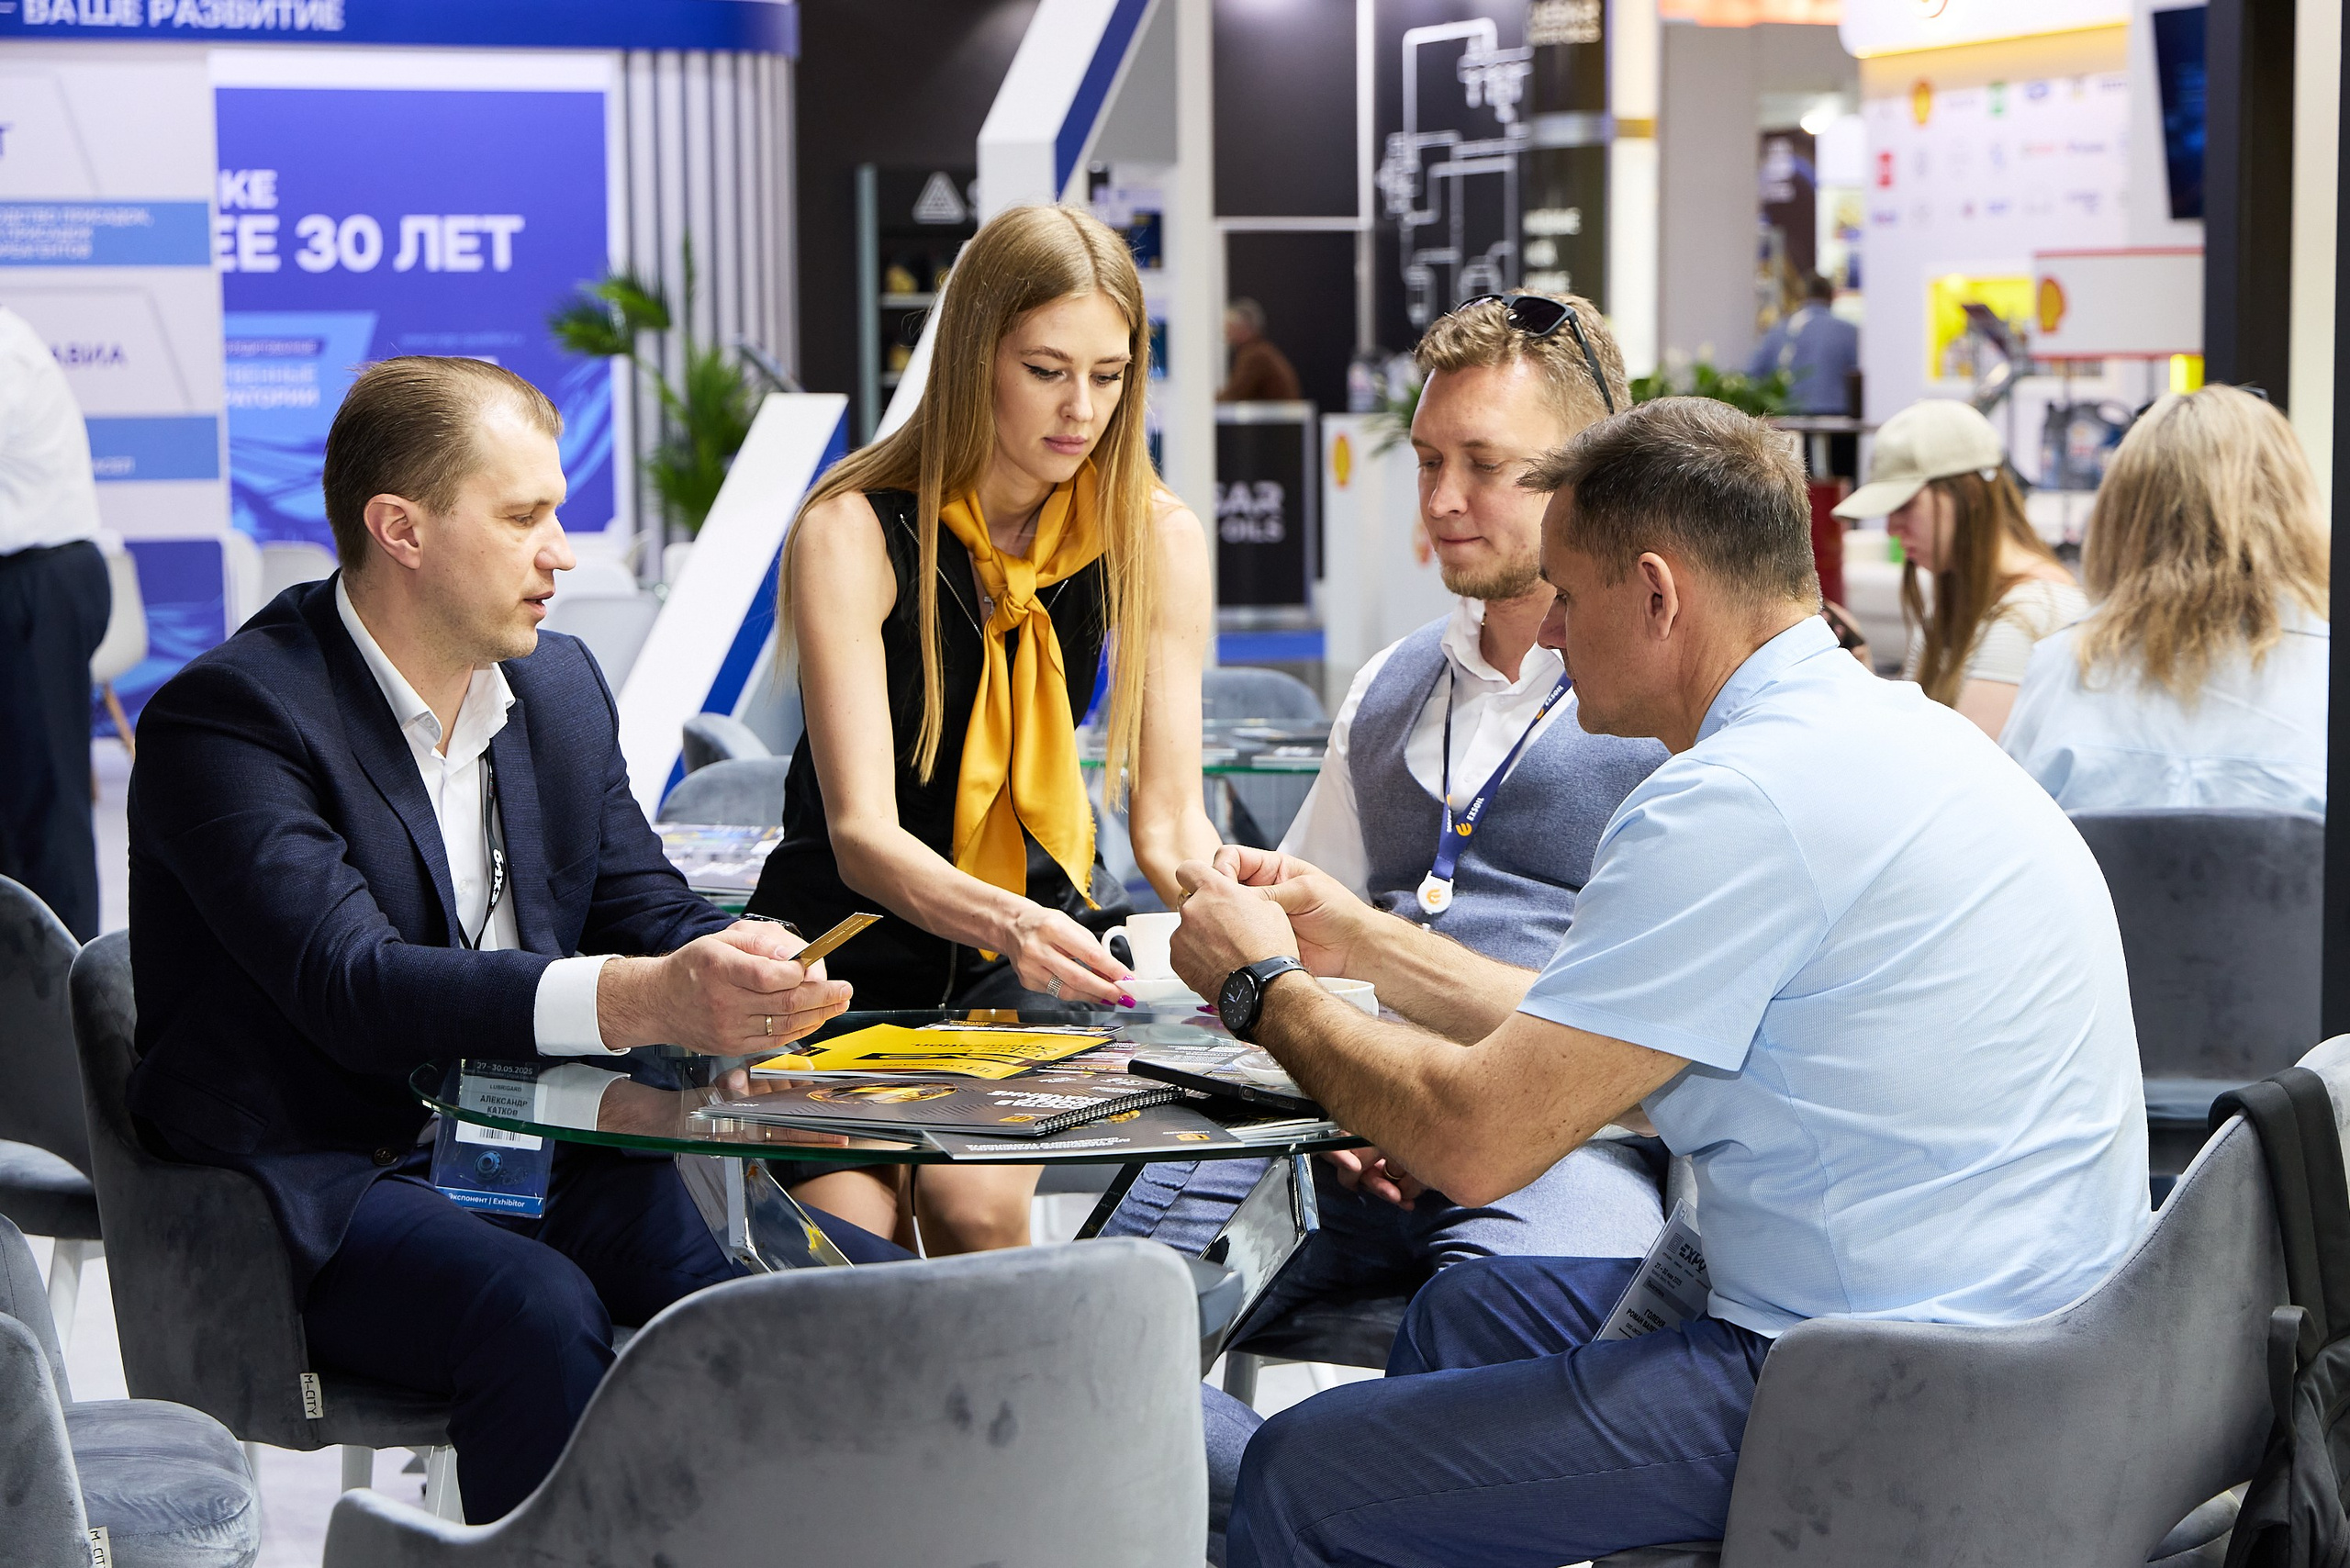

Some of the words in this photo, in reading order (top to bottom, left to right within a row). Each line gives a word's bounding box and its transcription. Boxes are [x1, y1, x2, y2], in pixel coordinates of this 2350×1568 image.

[149, 0, 346, 31] РАЗВИТИЕ
[295, 213, 384, 274] 30
[393, 213, 526, 274] ЛЕТ
[1466, 796, 1485, 822] EXSOIL
[479, 1094, 528, 1107] АЛЕКСАНДР
[492, 1197, 526, 1208] Exhibitor
[1627, 1308, 1644, 1325] РОМАН
[1644, 1308, 1666, 1328] ГОЛЕНЯ
[304, 1374, 318, 1416] M-CITY
[90, 1530, 106, 1568] M-CIT
